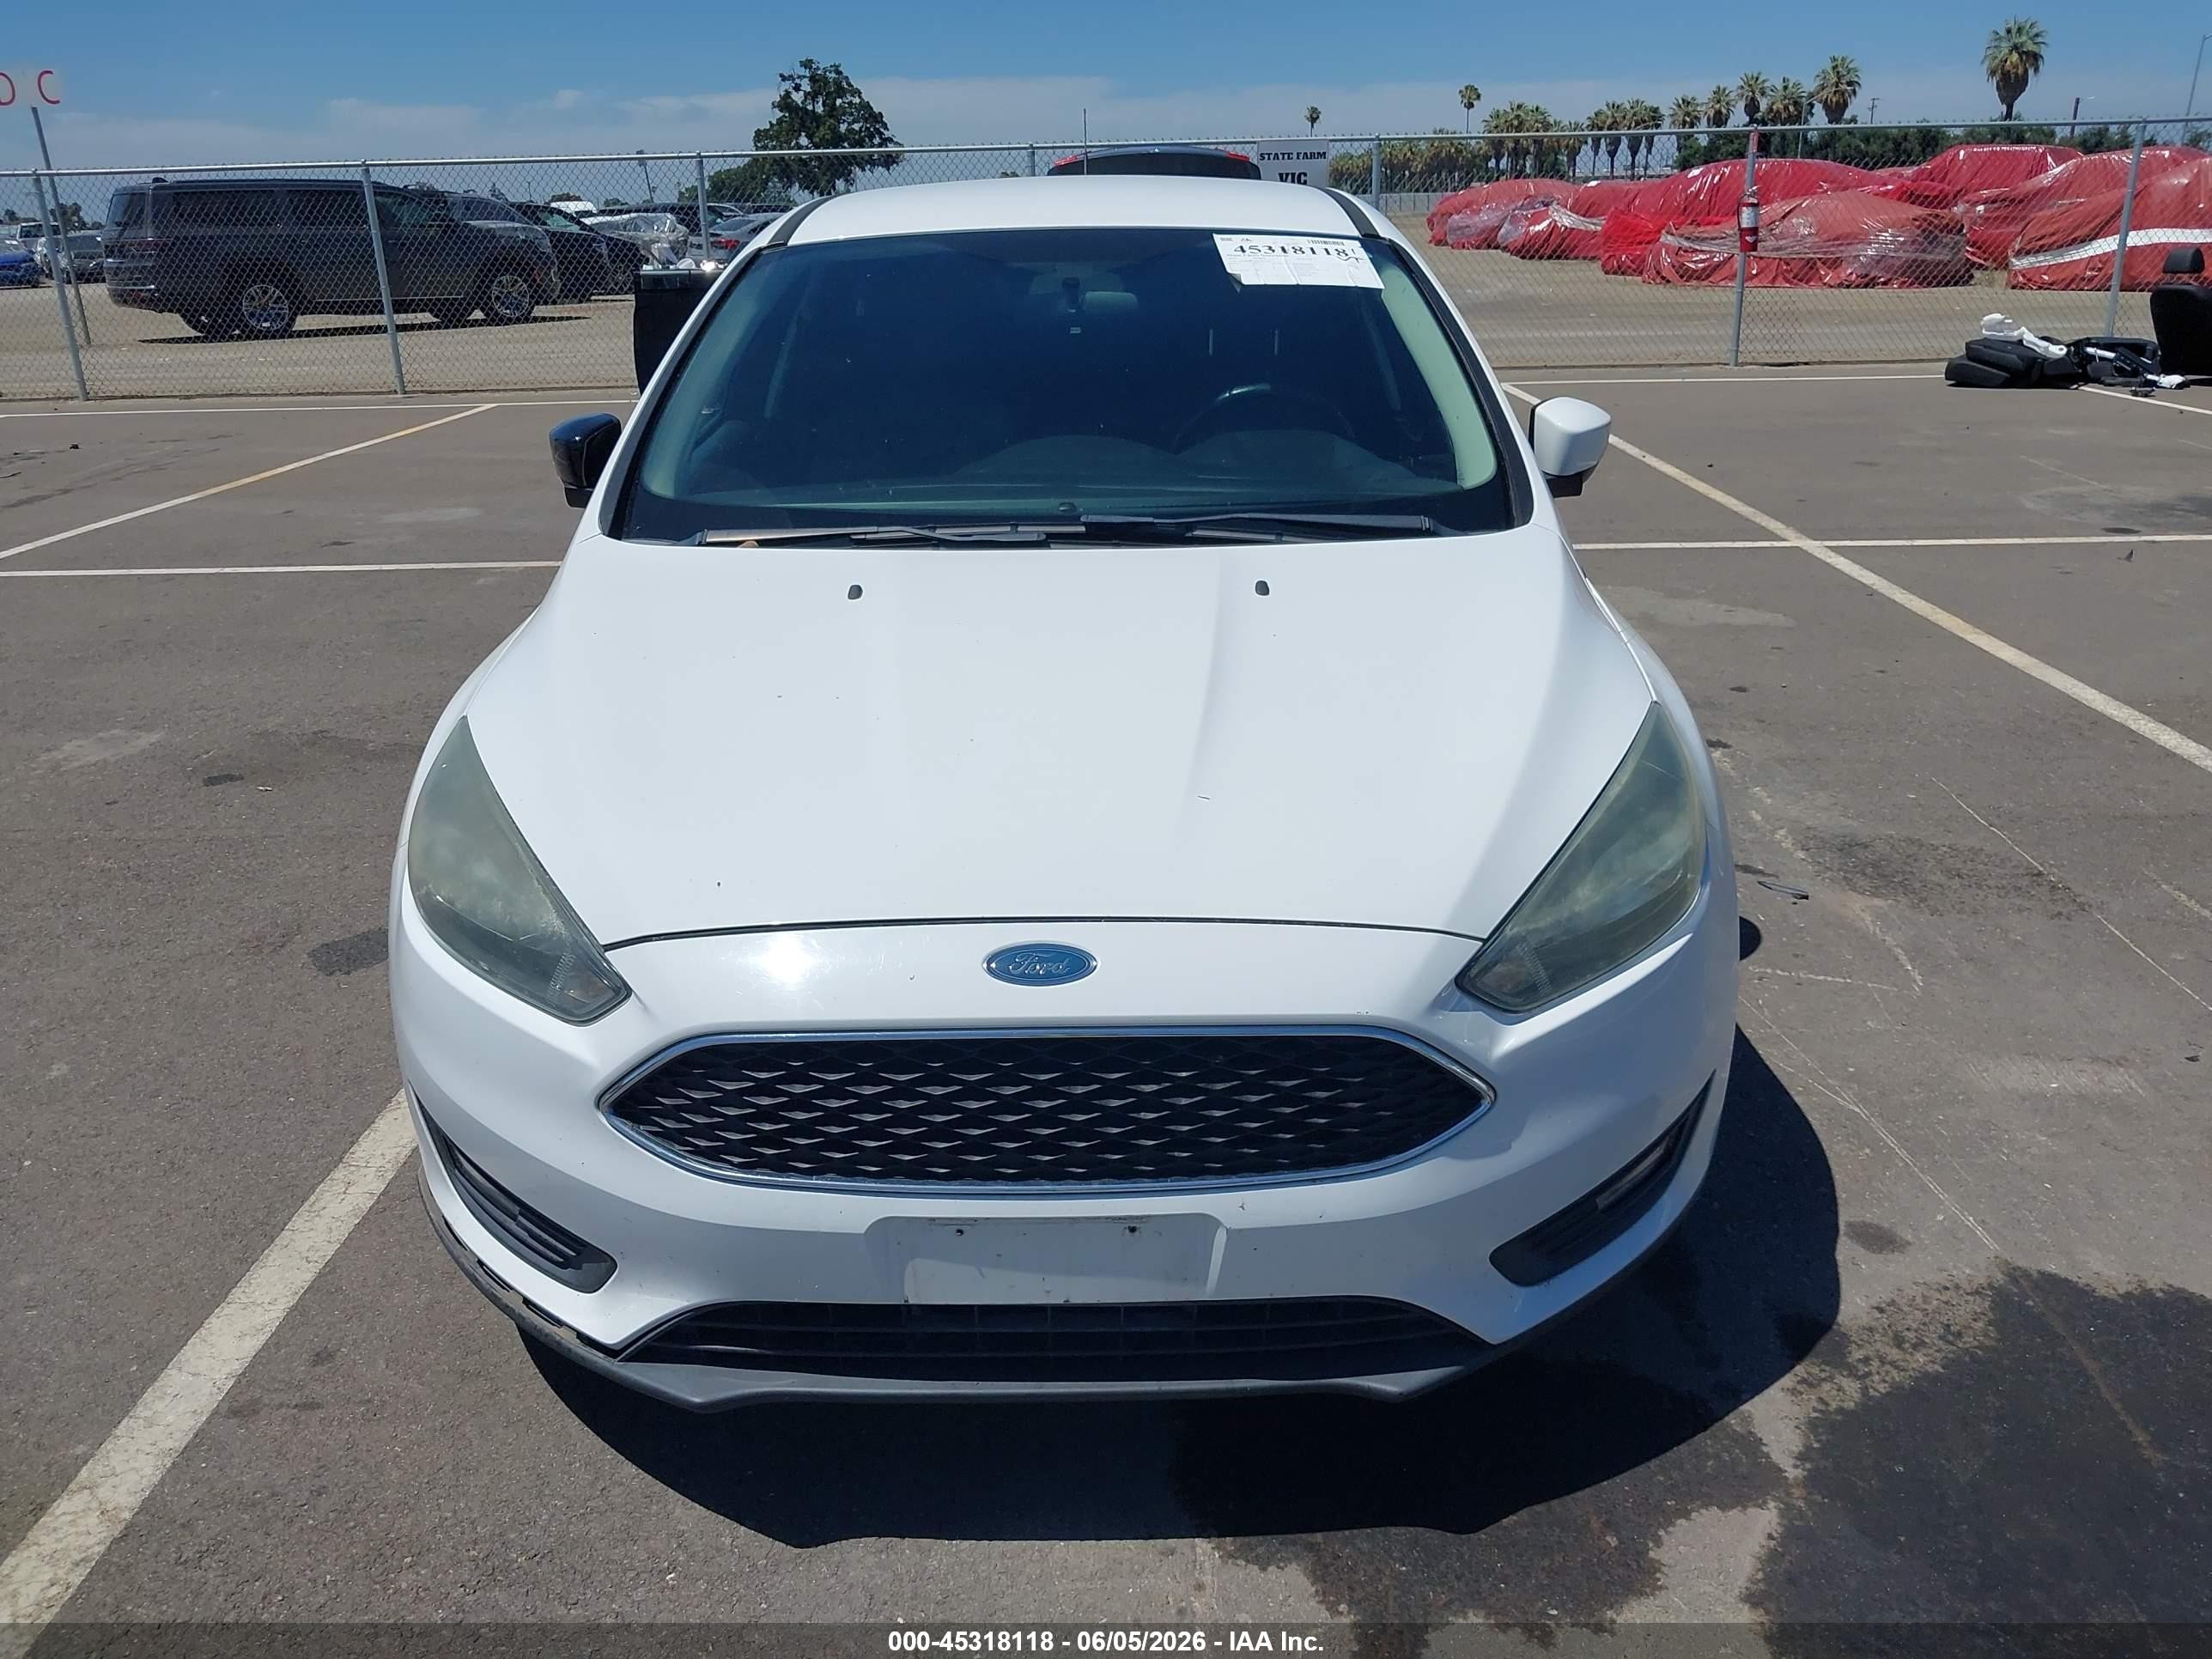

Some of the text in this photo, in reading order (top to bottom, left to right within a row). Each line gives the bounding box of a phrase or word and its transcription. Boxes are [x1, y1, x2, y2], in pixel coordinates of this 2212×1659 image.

[1259, 150, 1327, 161] STATE FARM
[1278, 171, 1308, 185] VIC
[1233, 245, 1349, 258] 45318118
[1009, 952, 1073, 975] Ford
